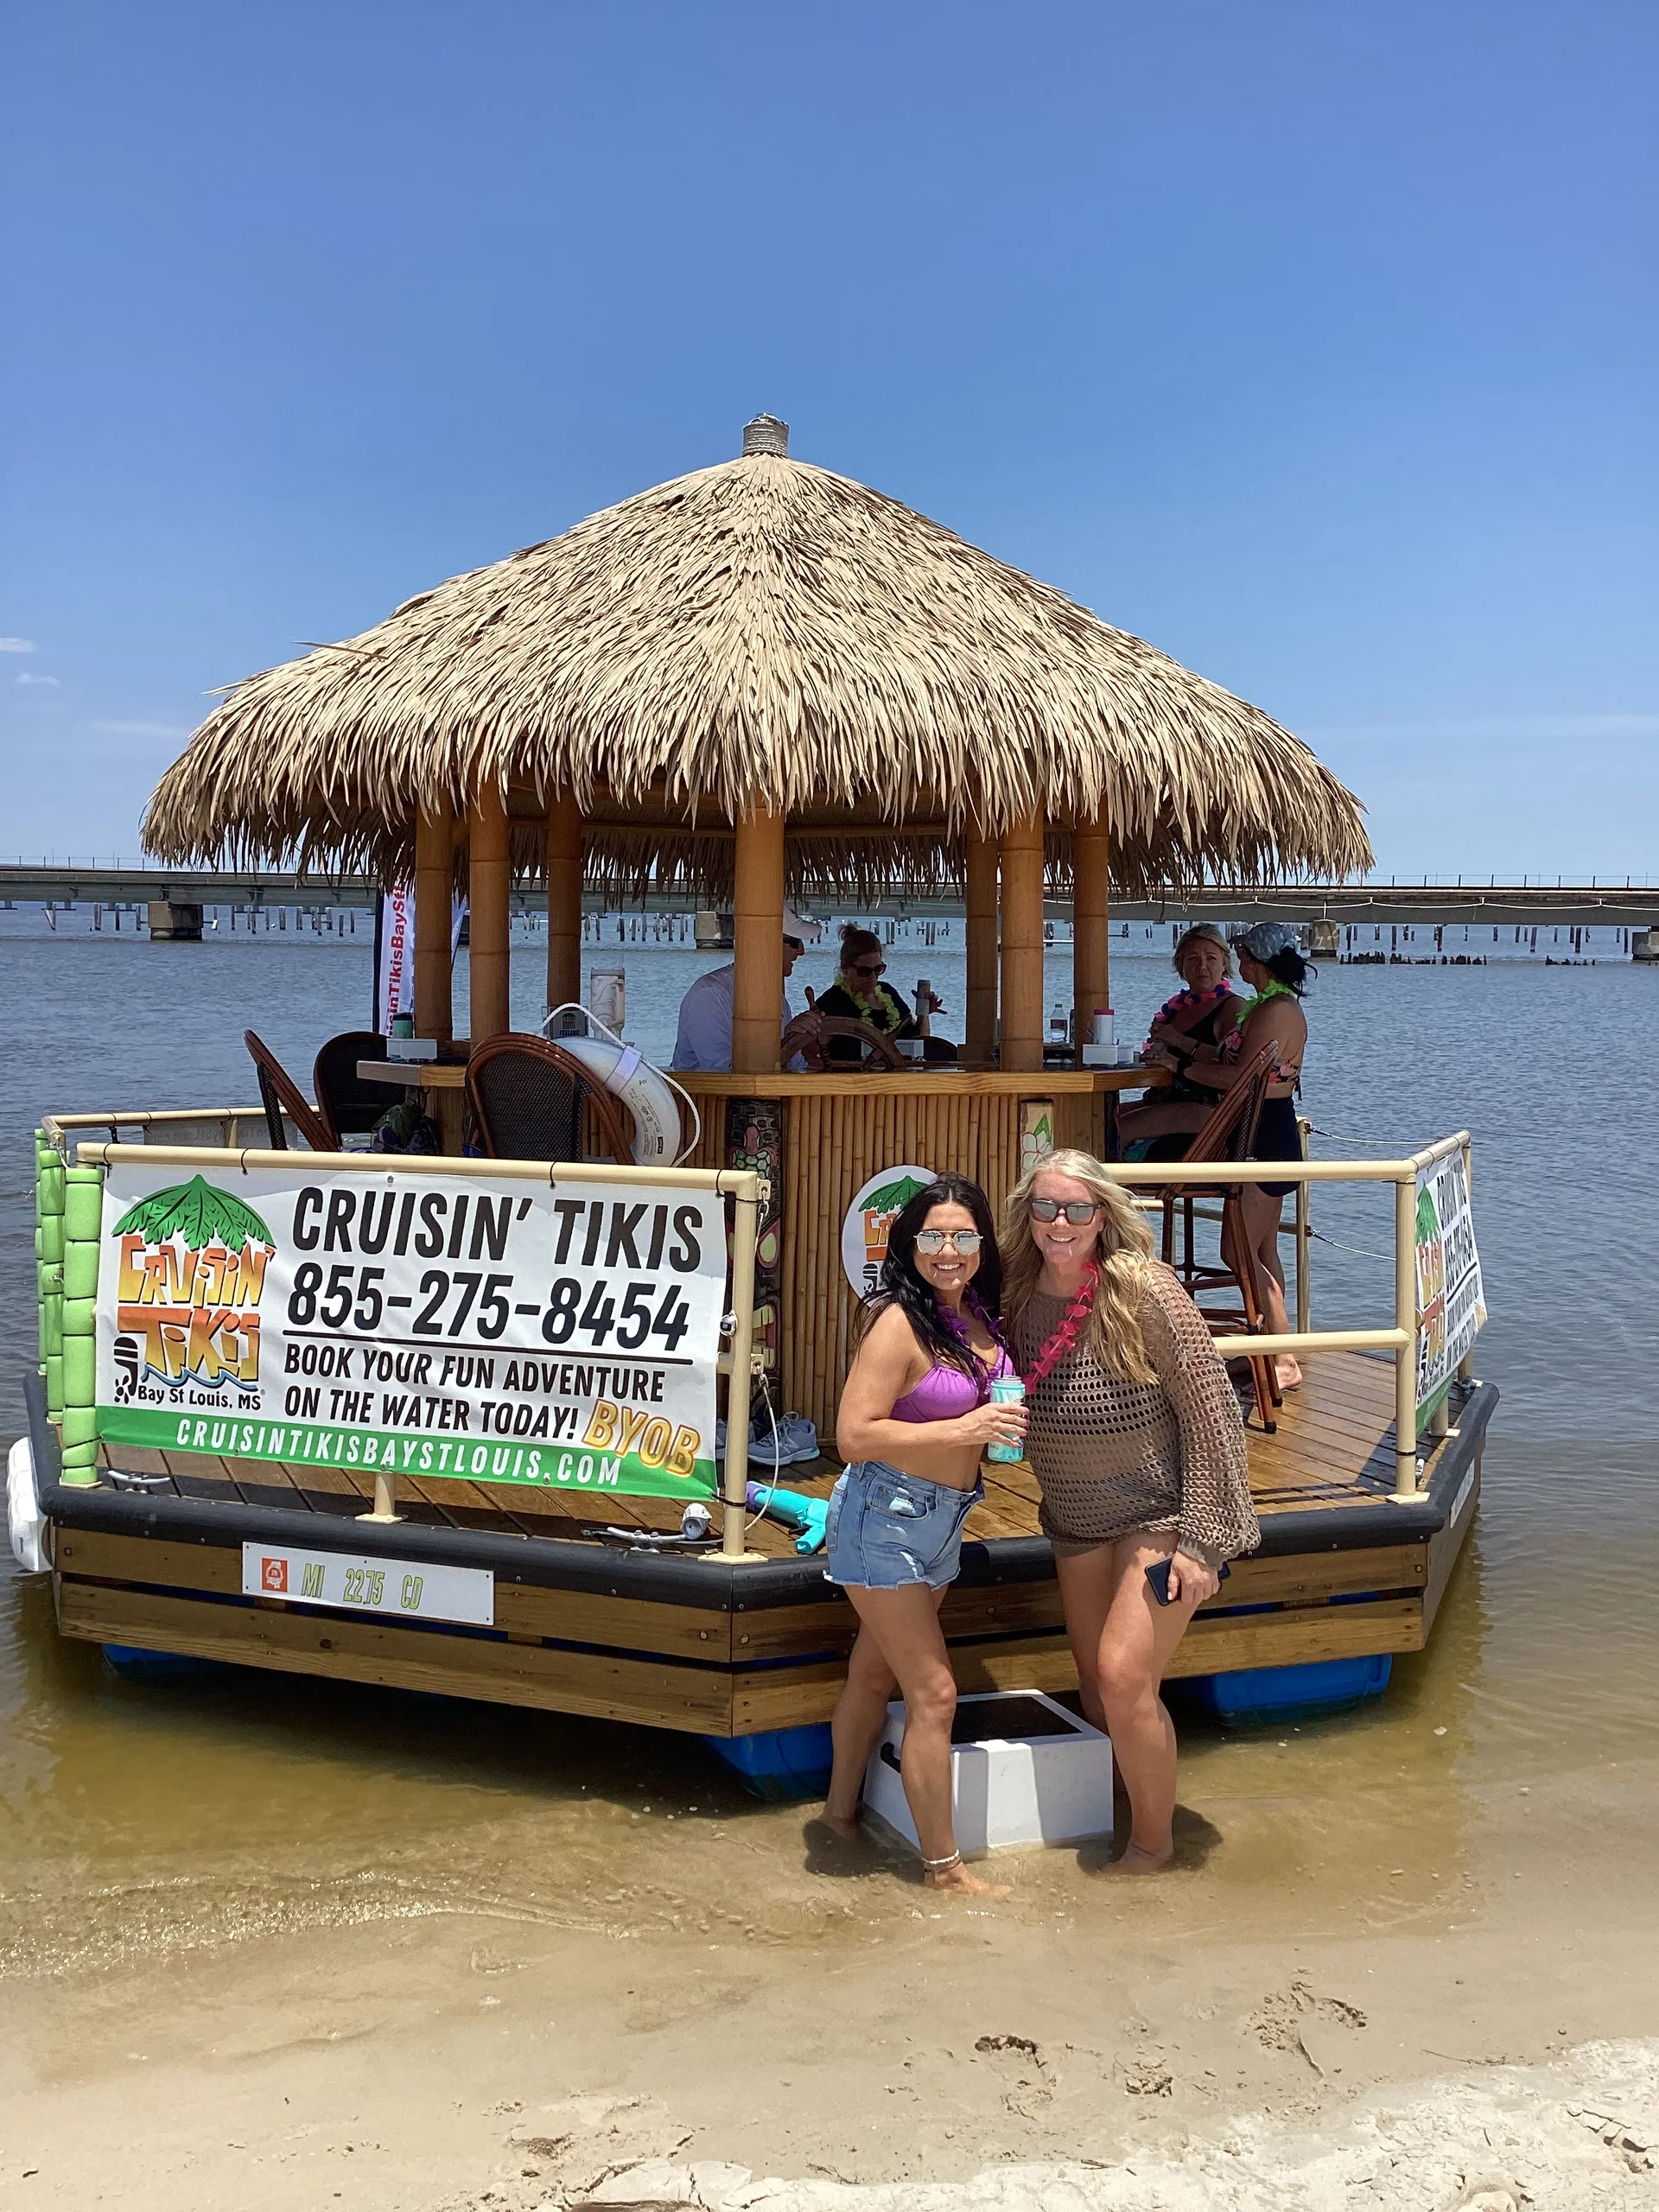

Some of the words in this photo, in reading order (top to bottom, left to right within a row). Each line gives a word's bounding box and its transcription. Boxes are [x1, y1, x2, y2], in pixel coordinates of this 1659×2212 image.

[293, 1187, 533, 1261] CRUISIN'
[554, 1199, 702, 1272] TIKIS
[288, 1262, 690, 1351] 855-275-8454
[138, 1385, 164, 1404] Bay
[169, 1388, 184, 1403] St
[189, 1389, 232, 1409] Louis,
[238, 1394, 261, 1410] MS
[284, 1344, 354, 1378] BOOK
[363, 1349, 432, 1385] YOUR
[439, 1355, 494, 1389] FUN
[503, 1360, 665, 1402] ADVENTURE
[284, 1386, 321, 1418] ON
[330, 1389, 374, 1423] THE
[382, 1394, 470, 1430] WATER
[480, 1402, 578, 1440] TODAY!
[582, 1398, 701, 1478] BYOB
[177, 1418, 622, 1486] CRUISINTIKISBAYSTLOUIS.COM
[302, 1563, 326, 1598] MI
[343, 1568, 385, 1605] 2275
